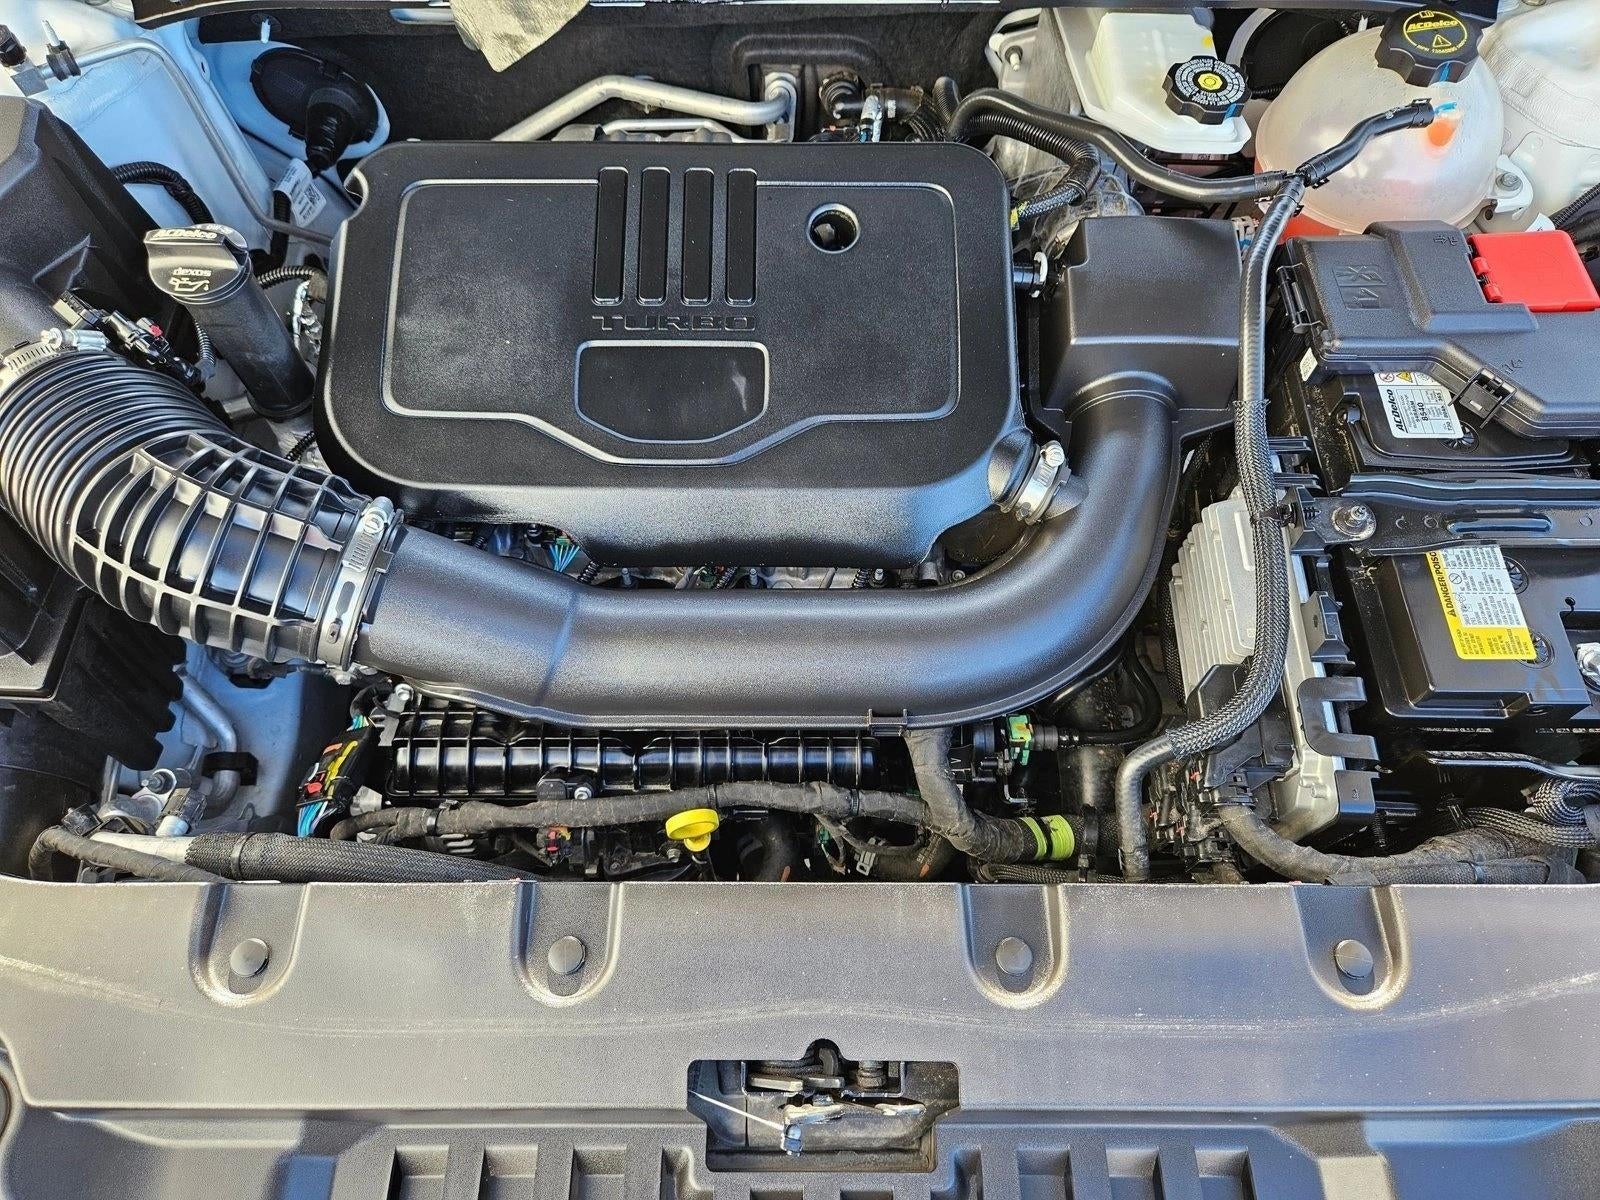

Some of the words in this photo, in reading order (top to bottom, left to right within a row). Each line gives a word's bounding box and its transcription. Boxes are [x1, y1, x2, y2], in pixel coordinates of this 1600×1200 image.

[1406, 20, 1459, 31] ACDelco
[152, 229, 218, 239] ACDelco
[173, 266, 212, 277] dexos
[592, 315, 756, 331] TURBO
[1386, 389, 1405, 432] ACDelco
[1429, 551, 1454, 609] DANGER/POISO
